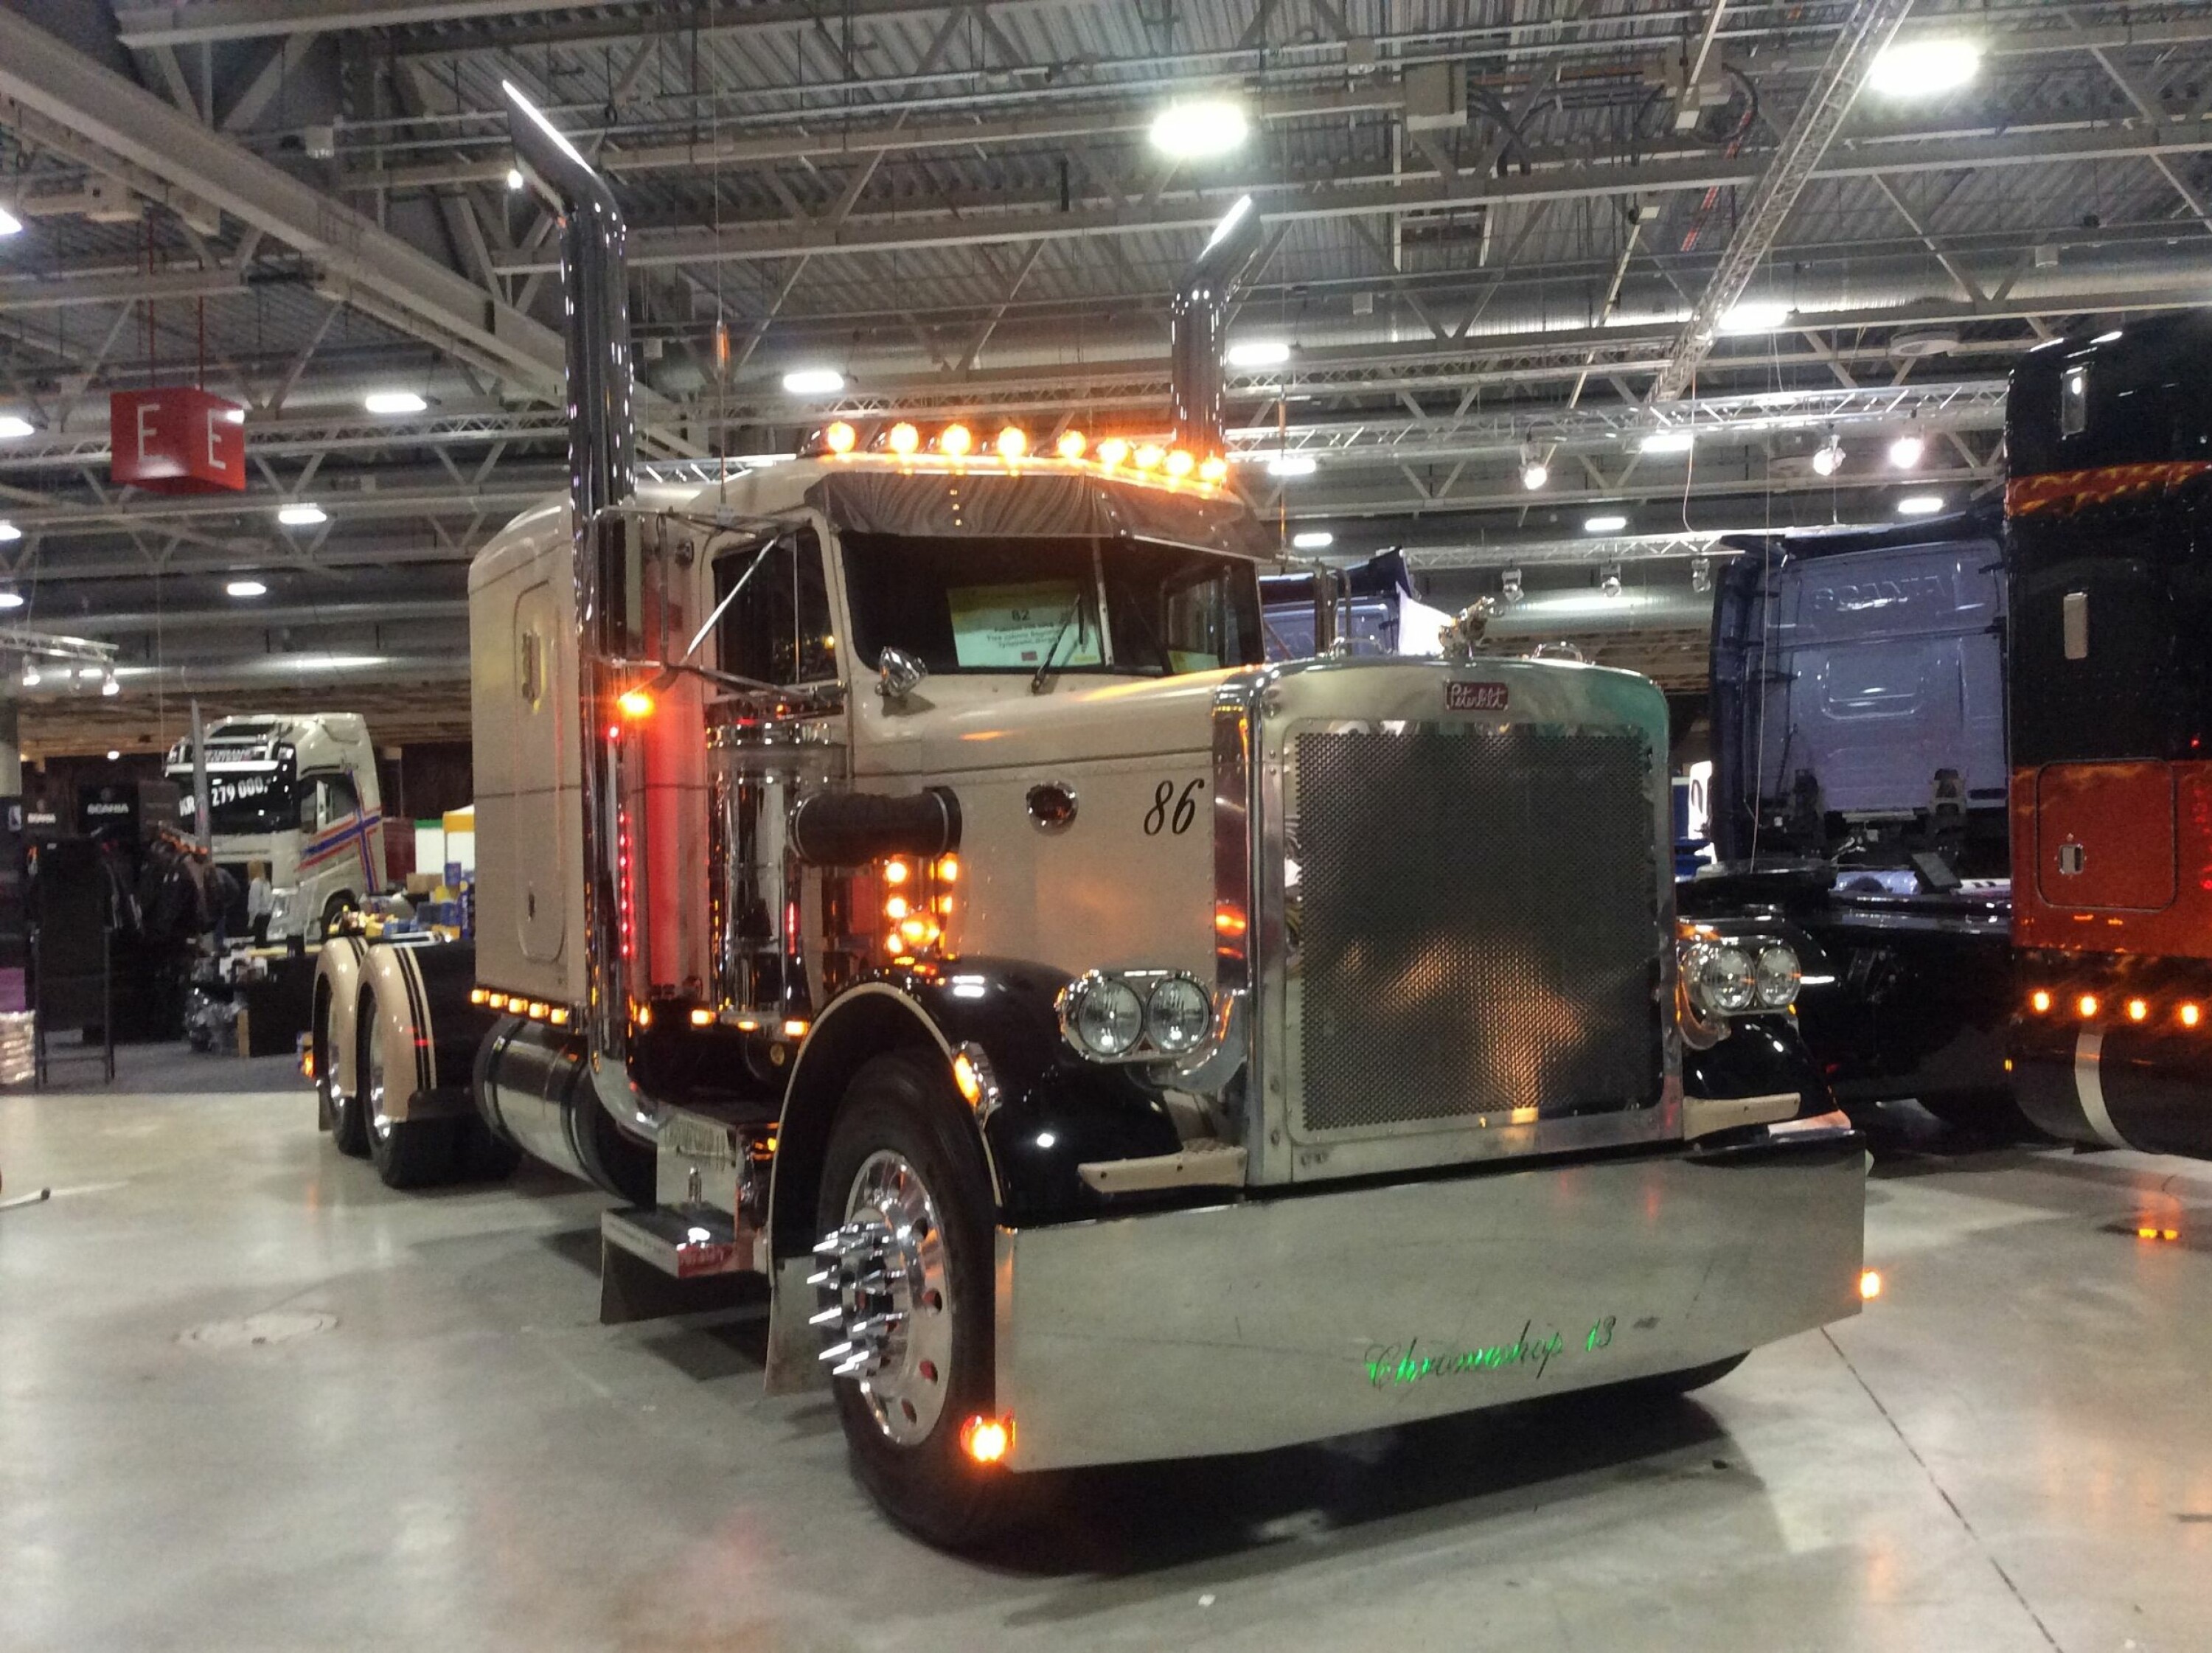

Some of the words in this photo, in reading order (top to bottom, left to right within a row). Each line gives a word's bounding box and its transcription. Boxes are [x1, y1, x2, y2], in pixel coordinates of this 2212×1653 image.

[137, 404, 161, 464] E
[207, 408, 226, 470] E
[1144, 779, 1205, 835] 86
